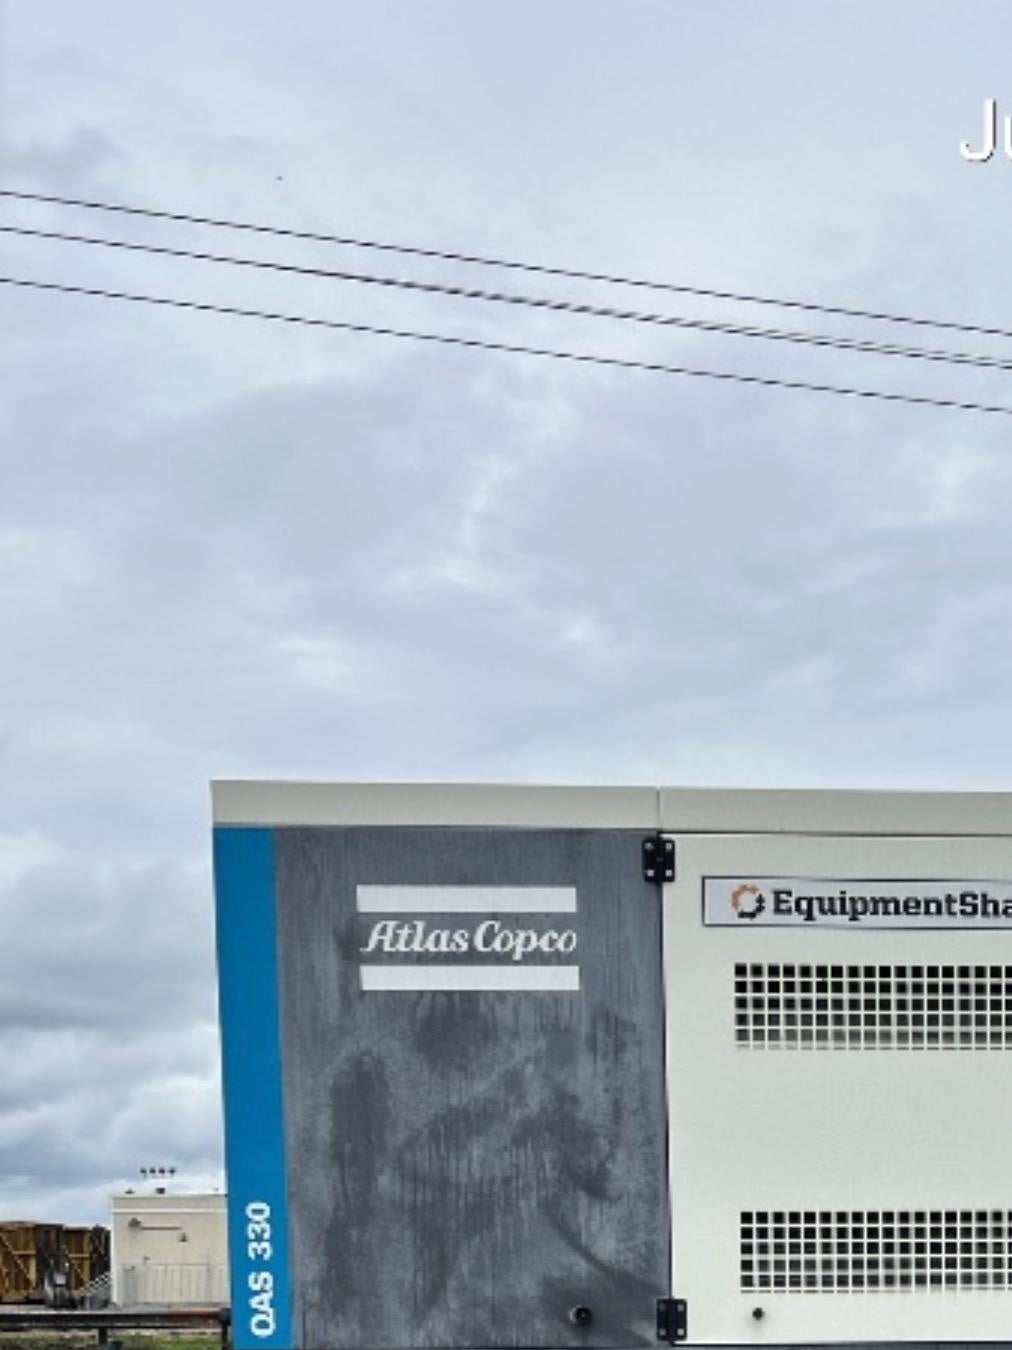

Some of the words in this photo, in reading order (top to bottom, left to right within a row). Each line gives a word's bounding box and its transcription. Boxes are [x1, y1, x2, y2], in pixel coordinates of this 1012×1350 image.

[359, 919, 470, 953] Atlas
[473, 919, 577, 961] Copco
[244, 1201, 273, 1262] 330
[248, 1270, 277, 1339] QAS
